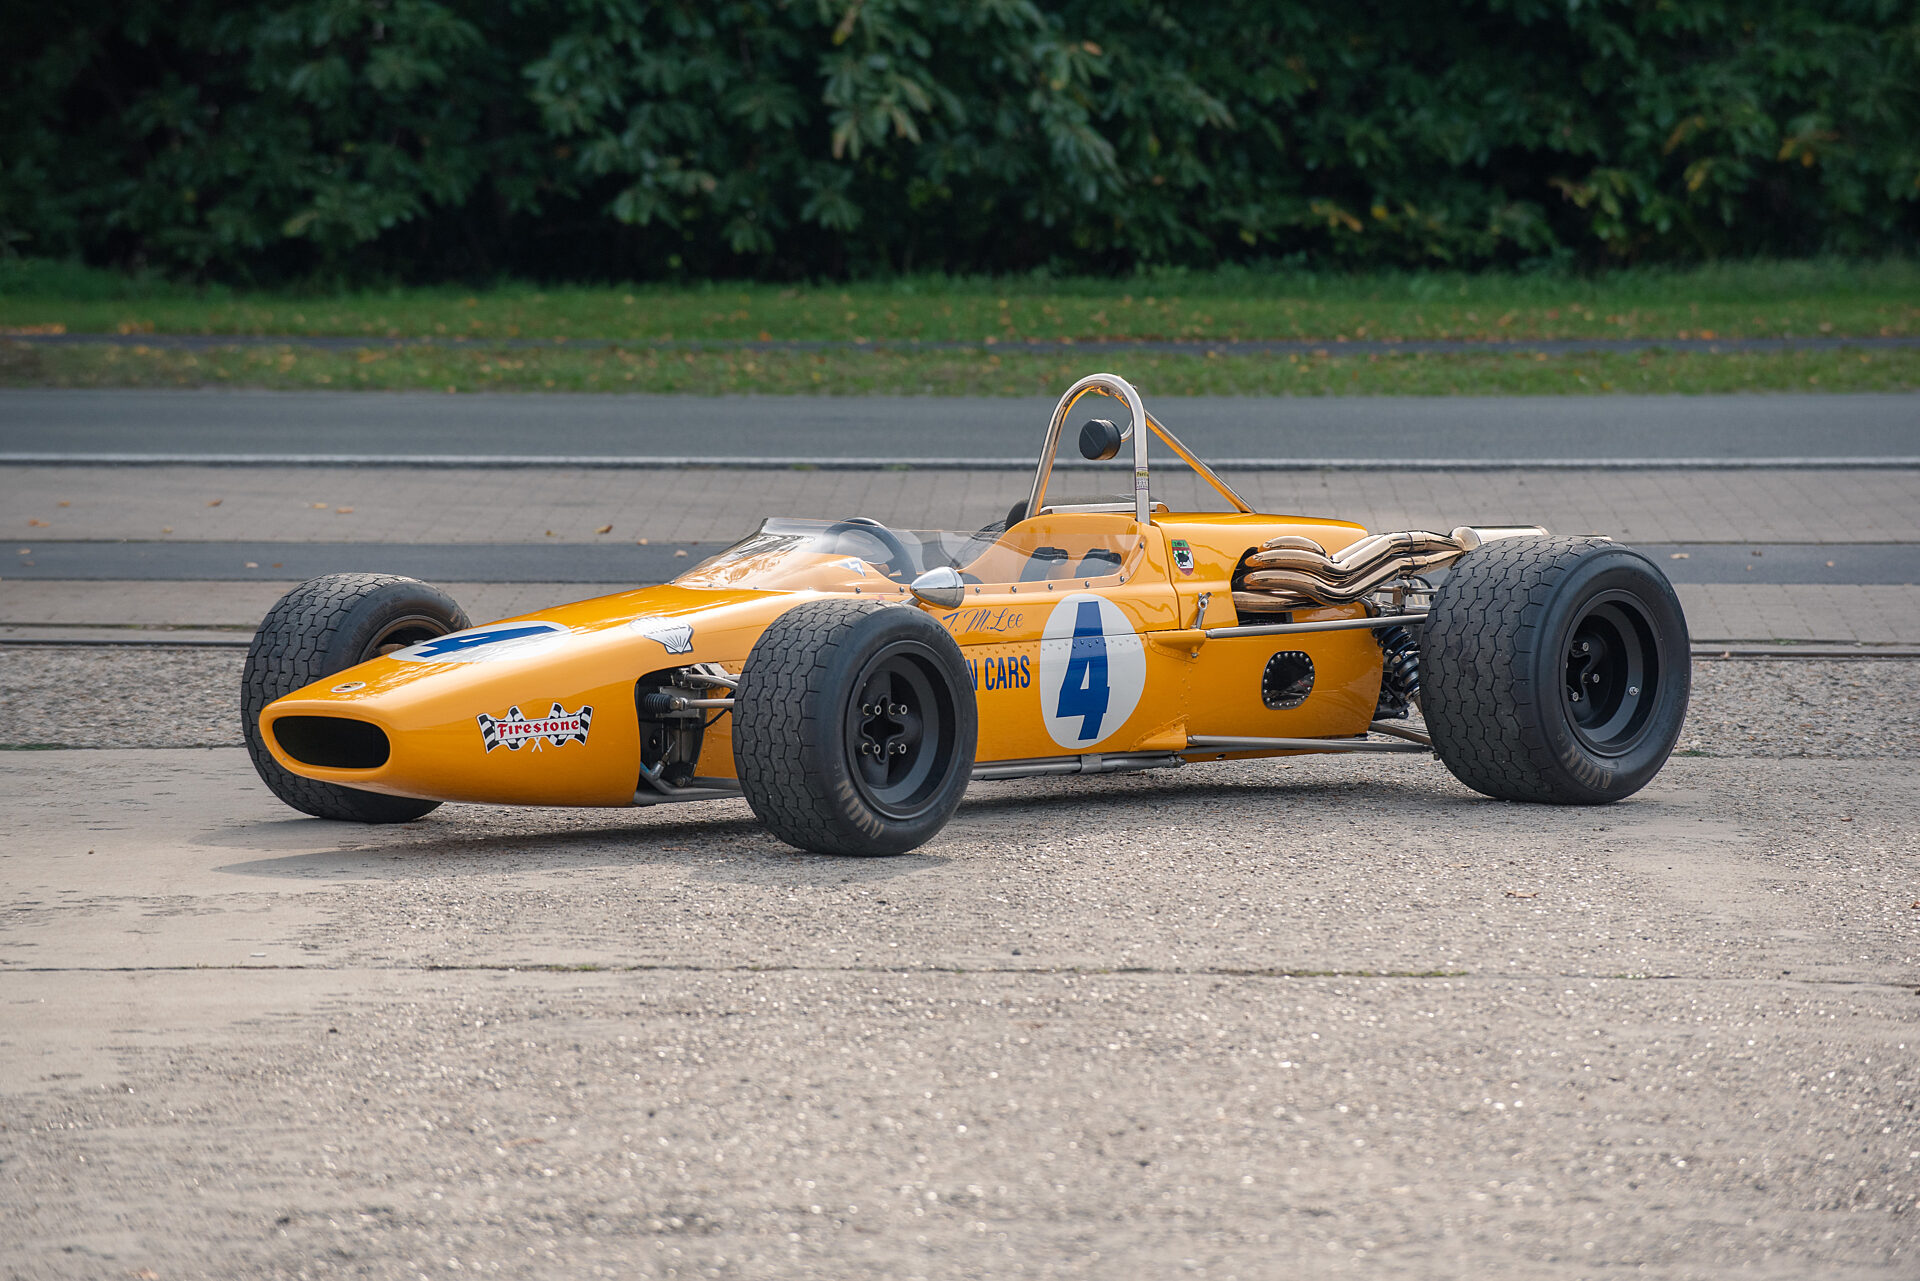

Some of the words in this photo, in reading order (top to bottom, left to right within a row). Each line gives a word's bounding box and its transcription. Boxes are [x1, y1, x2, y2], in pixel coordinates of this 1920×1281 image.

[984, 655, 1031, 691] CARS
[1056, 601, 1110, 740] 4
[497, 720, 579, 739] Firestone
